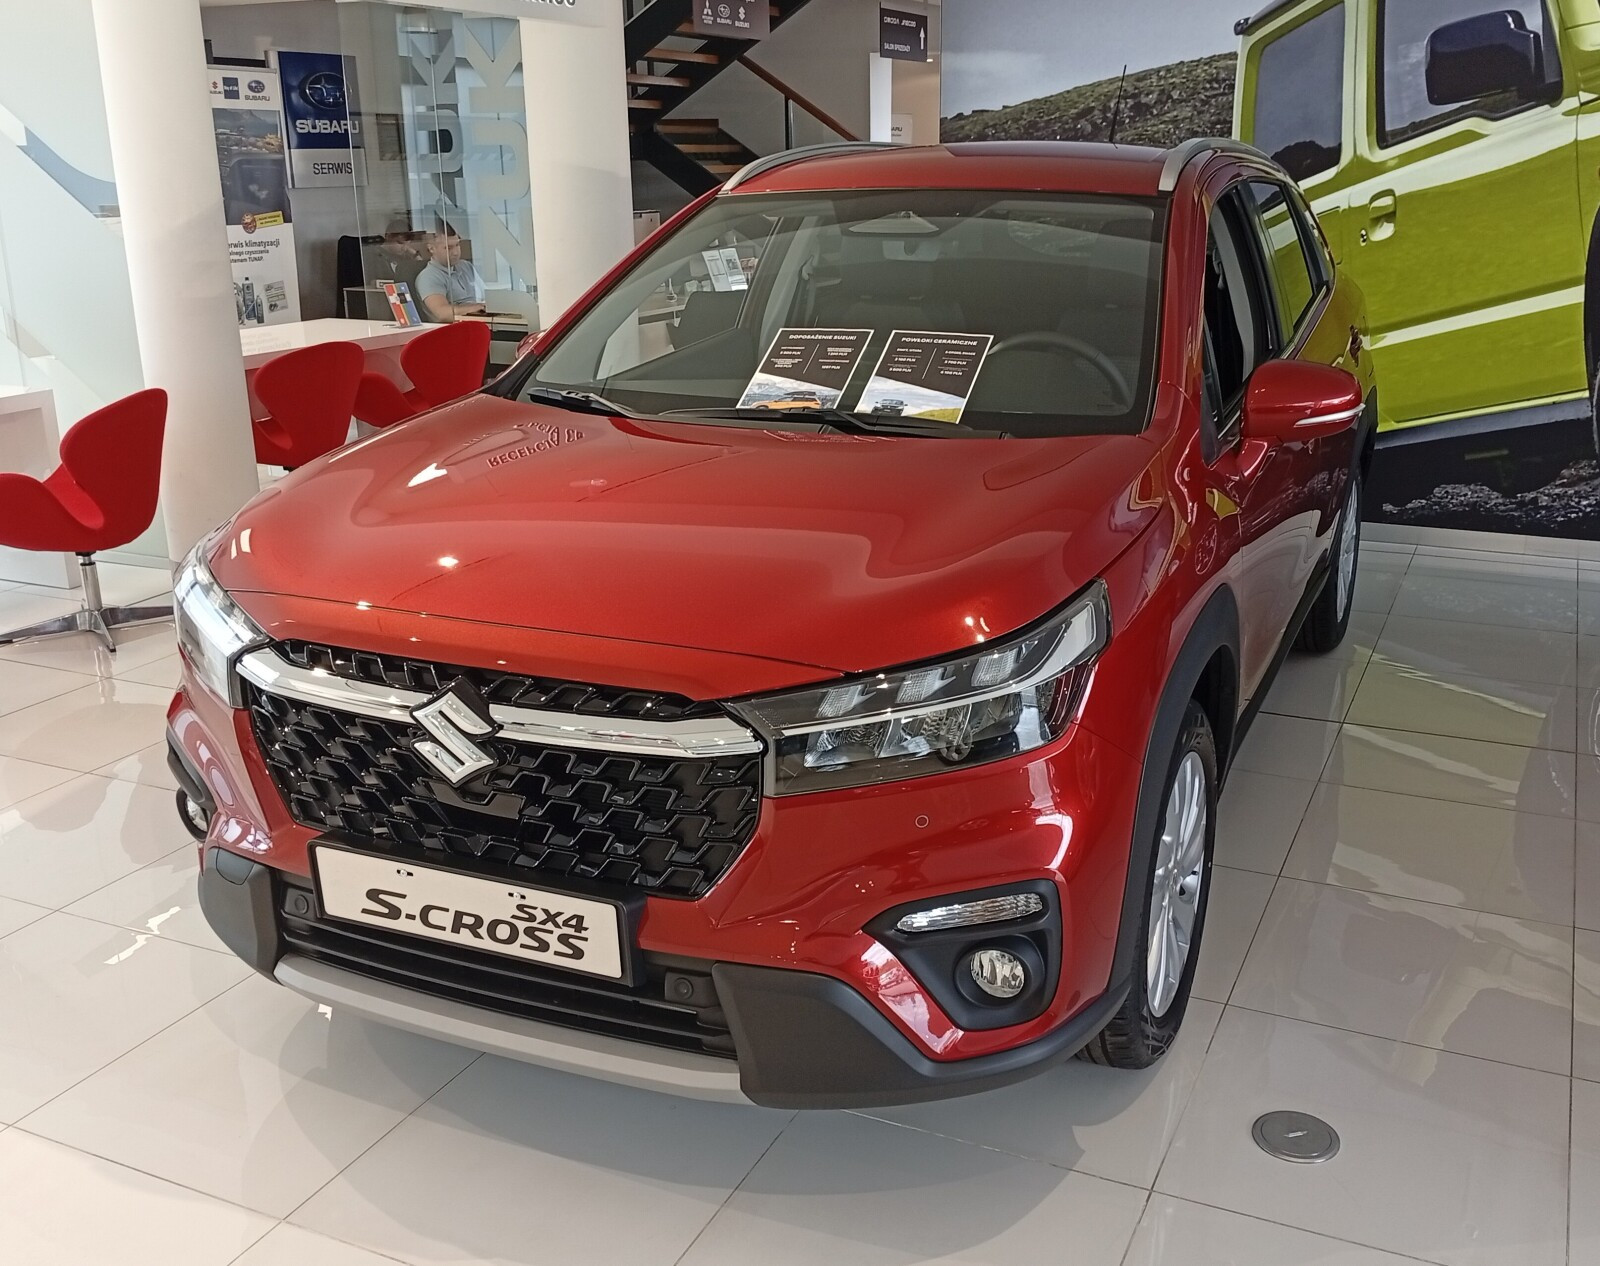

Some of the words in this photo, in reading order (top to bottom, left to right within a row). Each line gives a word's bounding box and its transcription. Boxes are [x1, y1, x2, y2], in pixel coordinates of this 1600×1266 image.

[313, 162, 353, 175] SERWIS
[244, 238, 280, 248] klimatyzacji
[901, 336, 933, 344] POWŁOKI
[933, 338, 978, 346] CERAMICZNE
[510, 903, 590, 934] SX4
